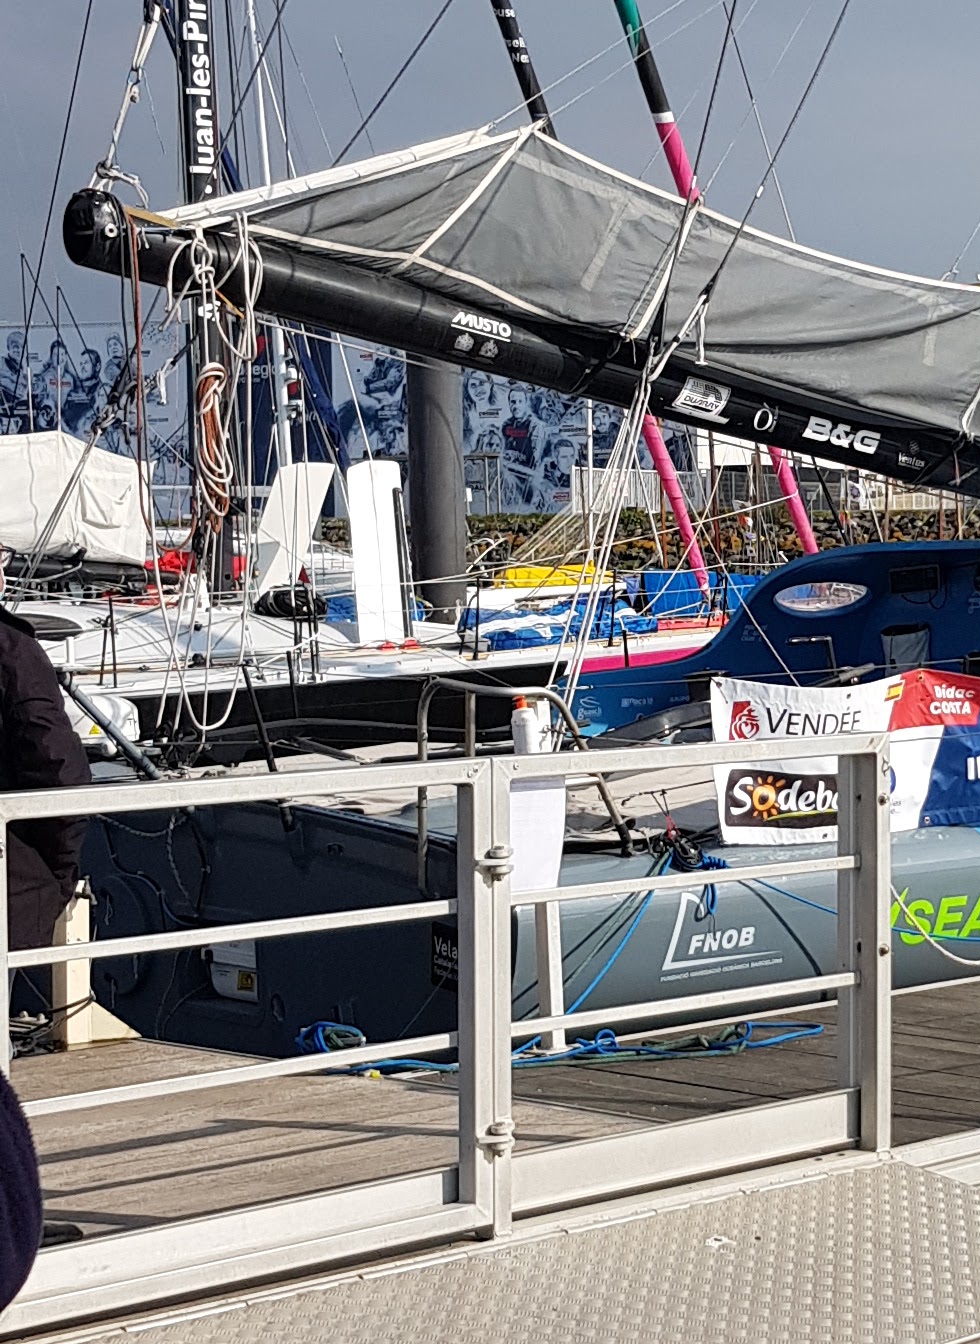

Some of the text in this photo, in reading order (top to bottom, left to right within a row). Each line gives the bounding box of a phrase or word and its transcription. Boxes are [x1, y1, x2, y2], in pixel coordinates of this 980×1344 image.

[452, 311, 512, 338] MUSTO
[802, 416, 882, 455] B&G
[766, 707, 862, 736] VENDÉE
[688, 927, 756, 955] FNOB
